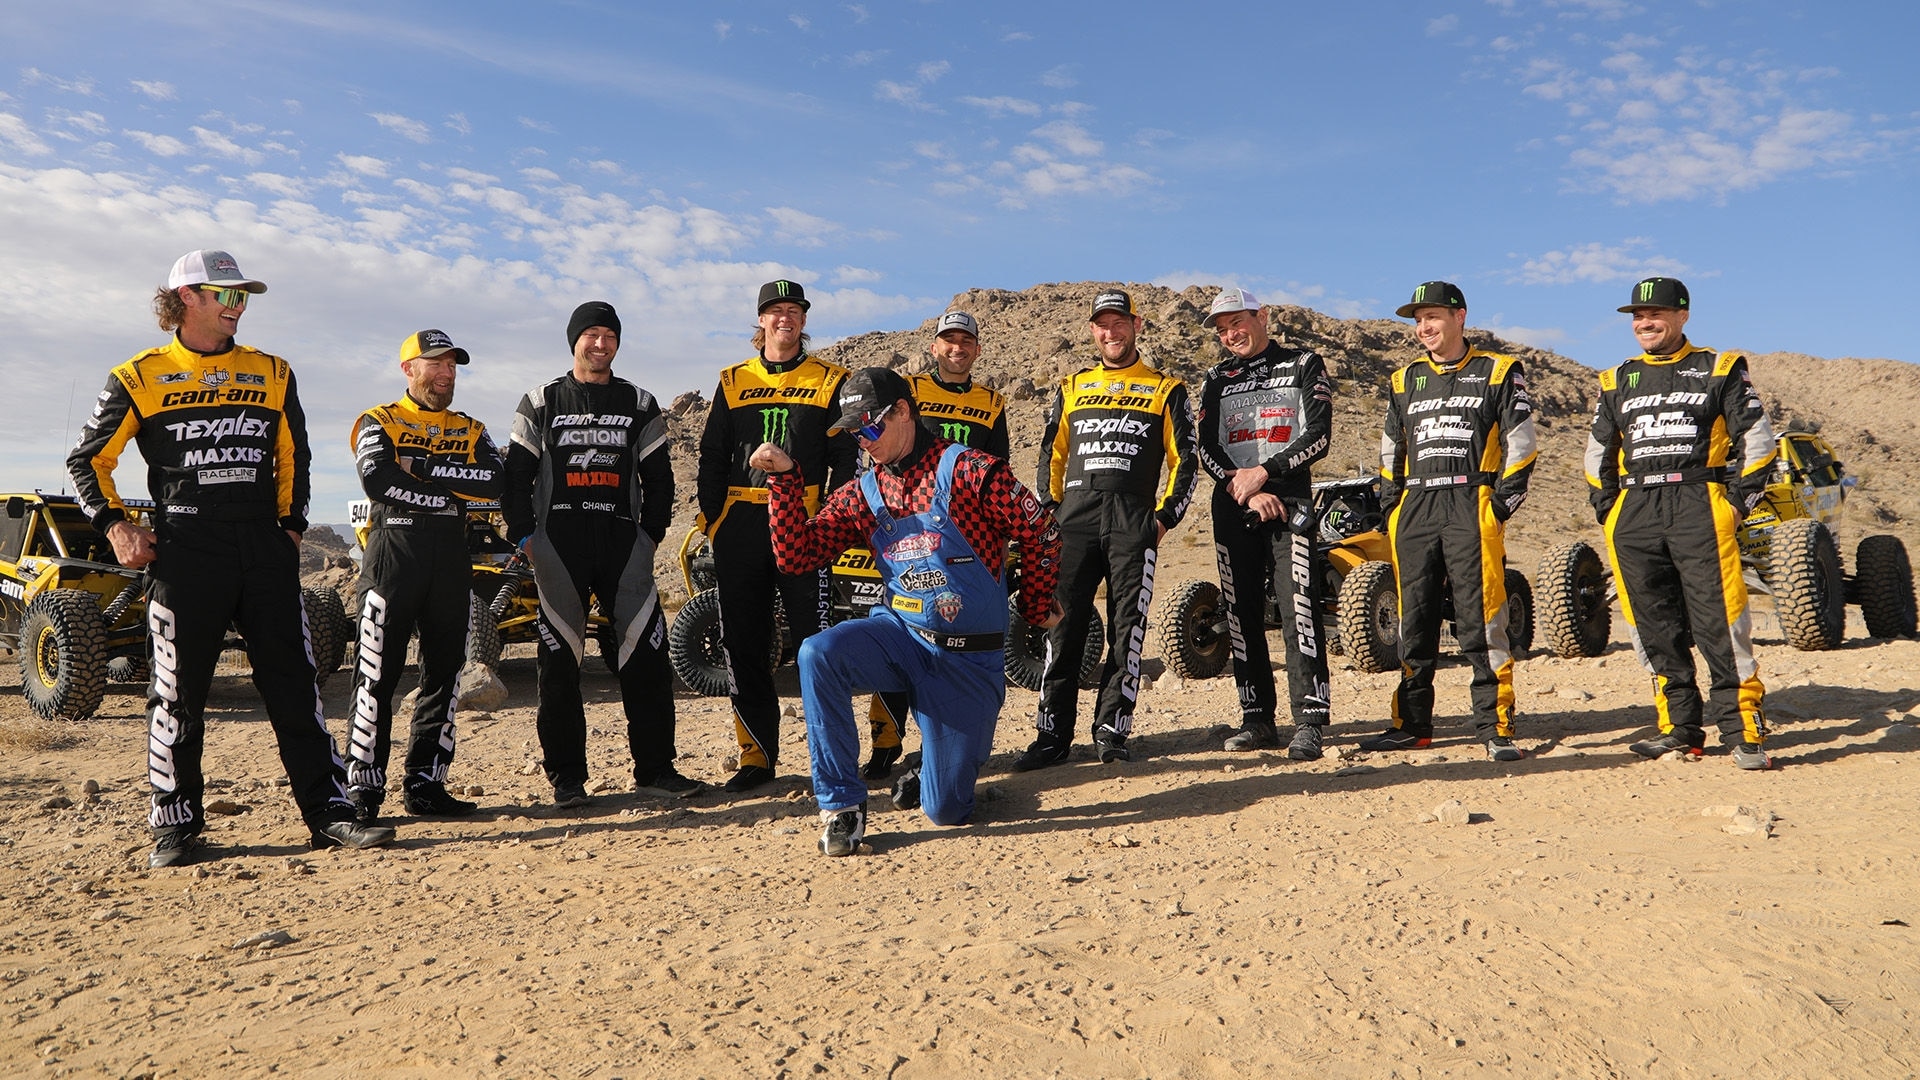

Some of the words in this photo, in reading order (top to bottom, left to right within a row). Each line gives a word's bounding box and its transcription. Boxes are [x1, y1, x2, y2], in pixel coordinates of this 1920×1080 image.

[739, 387, 817, 400] can-am
[1221, 376, 1294, 397] can-am
[162, 388, 268, 407] can-am
[1075, 395, 1153, 408] can-am
[1230, 393, 1282, 410] MAXXIS
[1407, 396, 1484, 415] can-am
[1621, 392, 1708, 414] can-am
[919, 400, 992, 421] can-am
[551, 413, 633, 429] can-am
[183, 447, 263, 467] MAXXIS
[1077, 441, 1139, 456] MAXXIS
[1288, 435, 1328, 470] MAXXIS
[1086, 458, 1129, 466] RACELINE
[199, 469, 255, 479] RACELINE
[431, 466, 493, 481] MAXXIS
[1426, 476, 1453, 487] BLURTON
[1643, 474, 1666, 484] JUDGE
[384, 486, 446, 508] MAXXIS
[167, 504, 198, 514] sparco
[351, 504, 369, 523] 944
[582, 501, 616, 511] CHANEY
[912, 571, 943, 581] NITRO
[913, 579, 947, 590] CIRCUS
[1216, 543, 1249, 663] can-am
[1291, 533, 1319, 658] can-am
[894, 599, 919, 610] can-am
[1122, 548, 1157, 702] can-am
[350, 589, 387, 764] can-am
[149, 600, 179, 793] can-am
